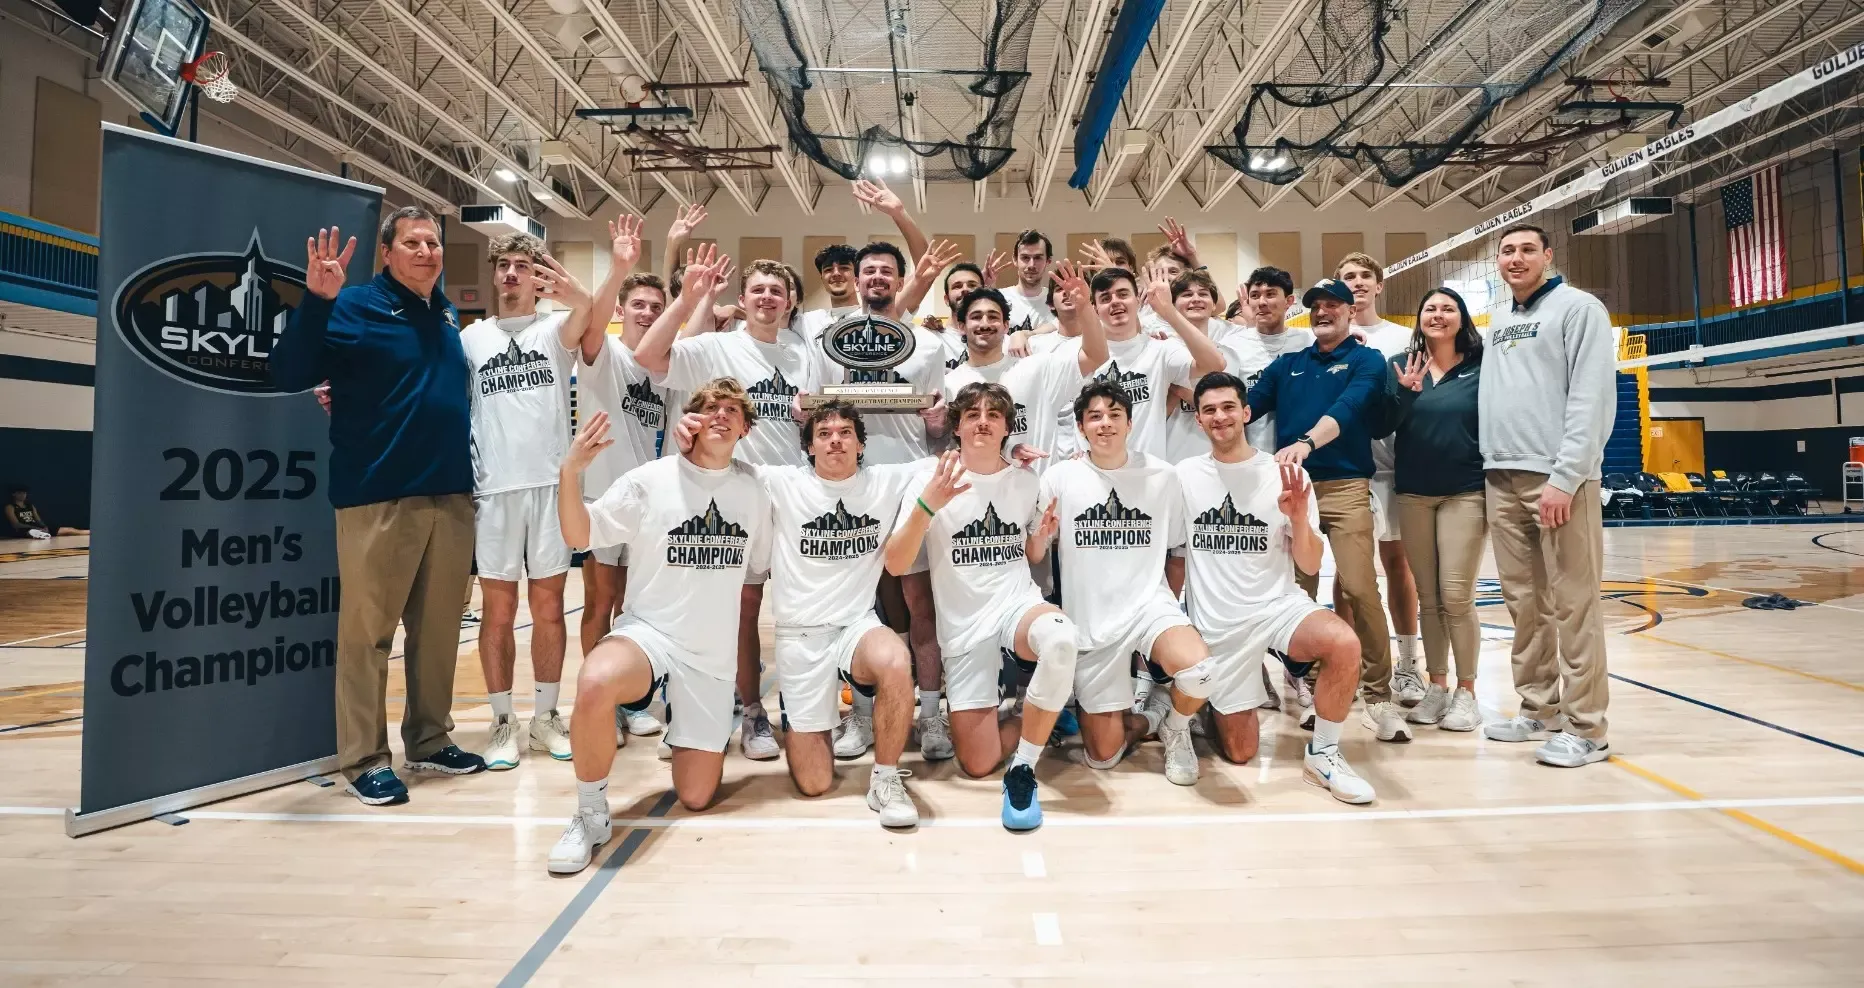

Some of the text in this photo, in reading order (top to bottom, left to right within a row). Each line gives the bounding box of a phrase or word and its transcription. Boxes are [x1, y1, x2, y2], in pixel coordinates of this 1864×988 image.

[1812, 43, 1864, 80] GOLDE
[1602, 126, 1695, 177] GOLDEN EAGLES
[1503, 202, 1533, 222] EAGLES
[160, 326, 279, 358] SKYL
[842, 344, 895, 352] SKYLINE
[187, 355, 271, 371] CONFERE
[481, 369, 555, 395] CHAMPIONS
[160, 447, 317, 501] 2025
[801, 523, 881, 538] SKYLINE CONFERENCE
[1074, 520, 1152, 528] SKYLINE CONFERENCE
[1219, 525, 1268, 533] CONFERENCE
[181, 525, 303, 568] Men's
[668, 535, 703, 544] SKYLINE
[800, 534, 879, 556] CHAMPIONS
[952, 536, 984, 546] SKYLINE
[1075, 530, 1151, 546] CHAMPIONS
[1193, 534, 1268, 551] CHAMPIONS
[667, 546, 744, 565] CHAMPIONS
[952, 543, 1024, 565] CHAMPIONS
[130, 577, 341, 632] Volleyball
[110, 636, 338, 697] Champion
